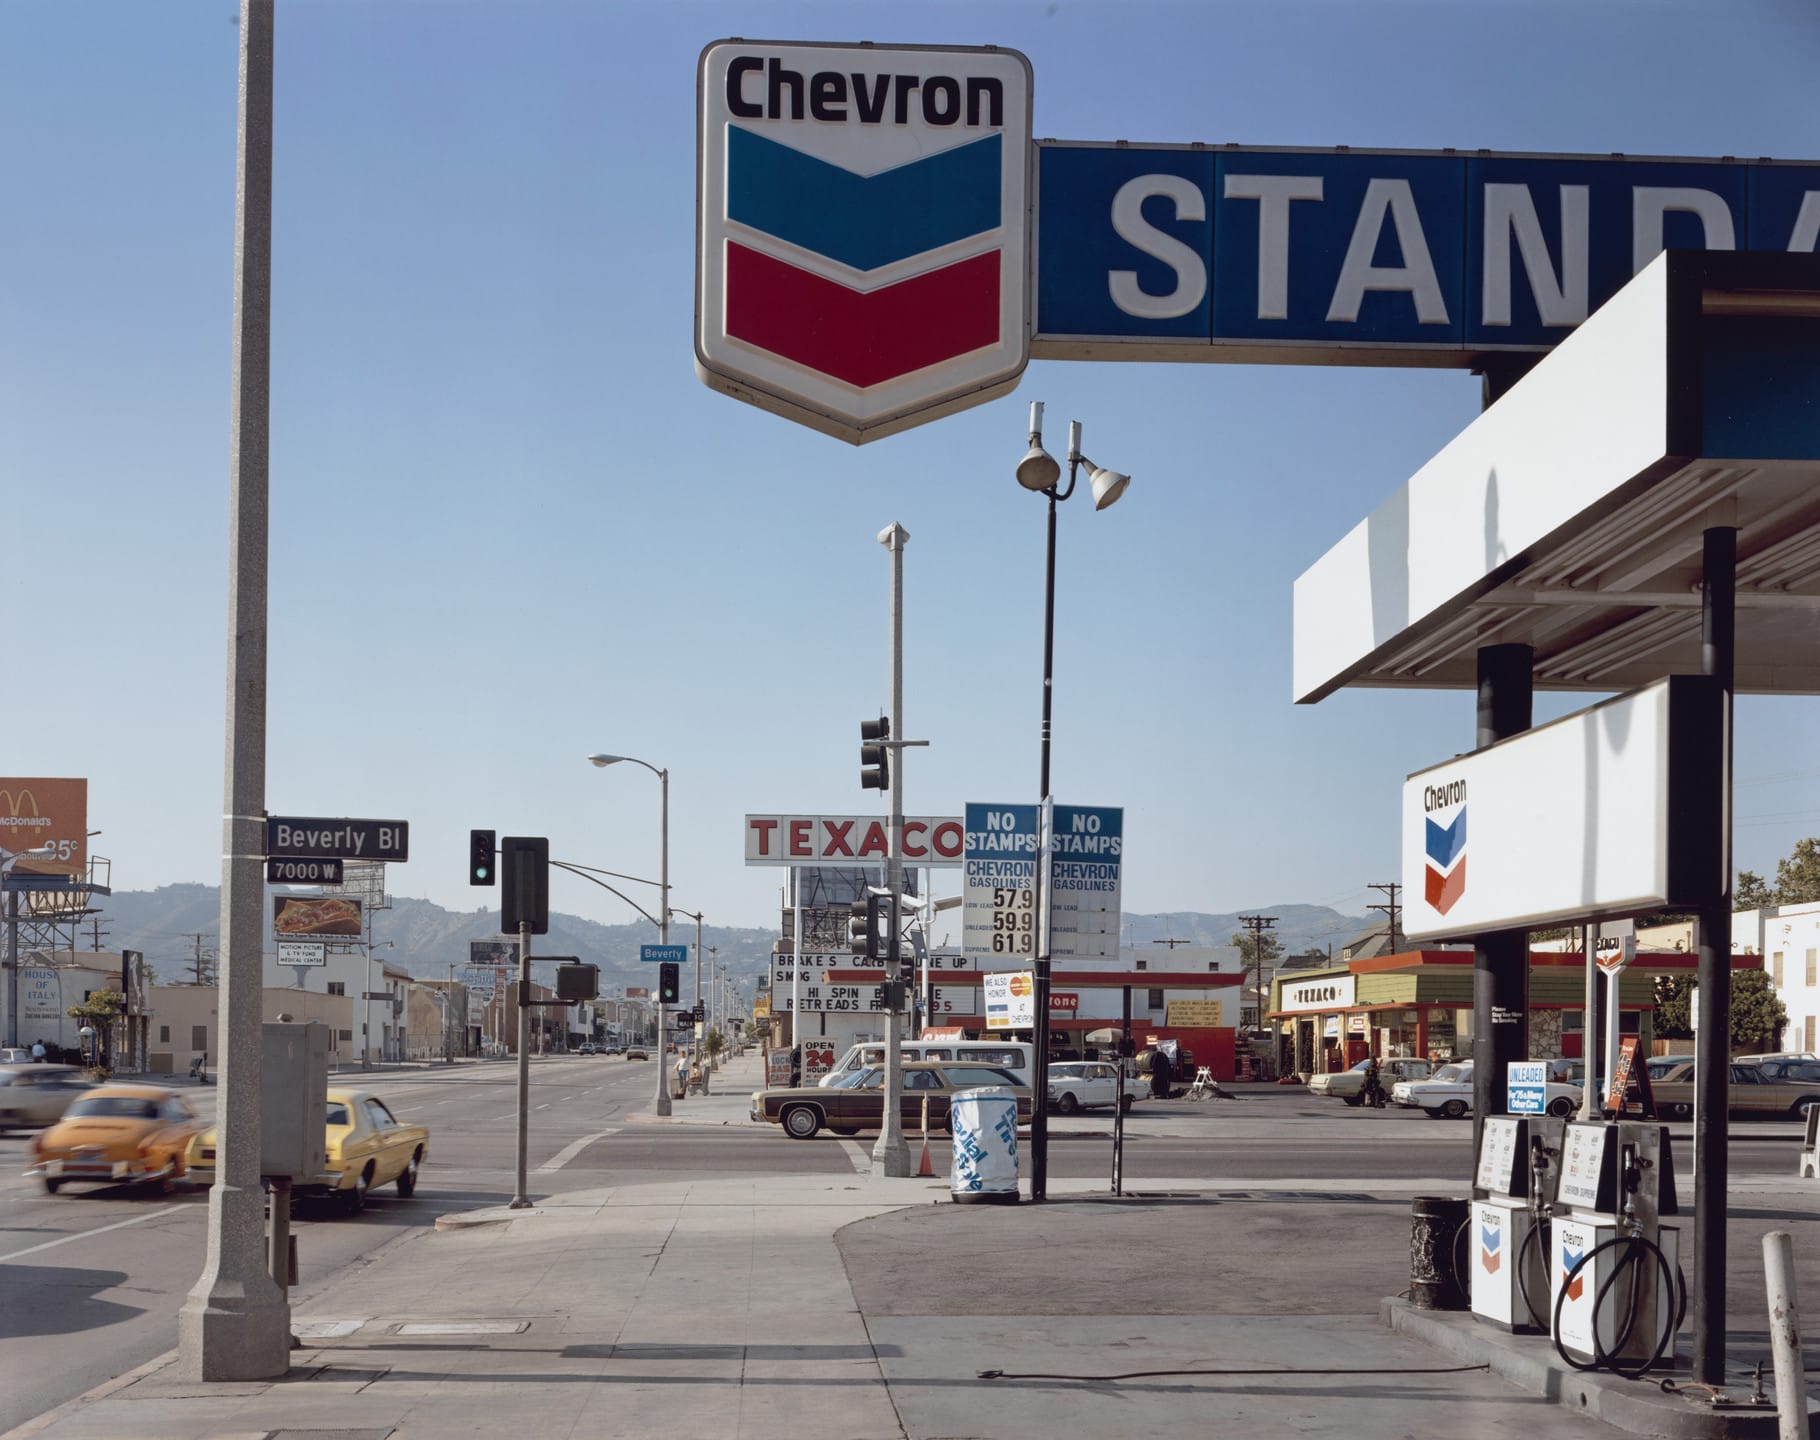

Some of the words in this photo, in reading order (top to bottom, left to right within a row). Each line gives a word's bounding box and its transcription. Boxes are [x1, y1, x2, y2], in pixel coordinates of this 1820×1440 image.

[725, 55, 1004, 127] Chevron
[1107, 172, 1820, 330] STAN
[1424, 779, 1467, 812] Chevron
[987, 812, 1016, 831] NO
[1072, 814, 1101, 833] NO
[277, 825, 366, 855] Beverly
[379, 828, 400, 850] Bl
[750, 819, 964, 857] TEXACO
[965, 832, 1037, 852] STAMPS
[1052, 834, 1121, 855] STAMPS
[276, 863, 318, 879] 7000
[323, 864, 335, 879] W
[967, 861, 1034, 877] CHEVRON
[1052, 863, 1118, 879] CHEVRON
[969, 877, 1031, 888] GASOLINES
[1054, 880, 1115, 891] GASOLINES
[993, 888, 1033, 909] 57.9
[993, 911, 1033, 931] 59.9
[993, 934, 1032, 953] 61.9
[644, 948, 682, 960] Beverly
[778, 955, 837, 966] BRAKES
[952, 958, 967, 969] UP
[35, 981, 49, 989] OF
[808, 988, 819, 998] HI
[832, 987, 859, 998] SPIN
[28, 991, 56, 999] ITALY
[1298, 986, 1336, 1004] TEXACO
[786, 1000, 859, 1010] RETREADS
[805, 1041, 834, 1049] OPEN
[805, 1050, 836, 1067] 24
[1509, 1067, 1544, 1082] UNLEADED
[953, 1104, 988, 1163] Radial
[1481, 1210, 1500, 1225] Chevron
[1563, 1230, 1583, 1247] Chevron
